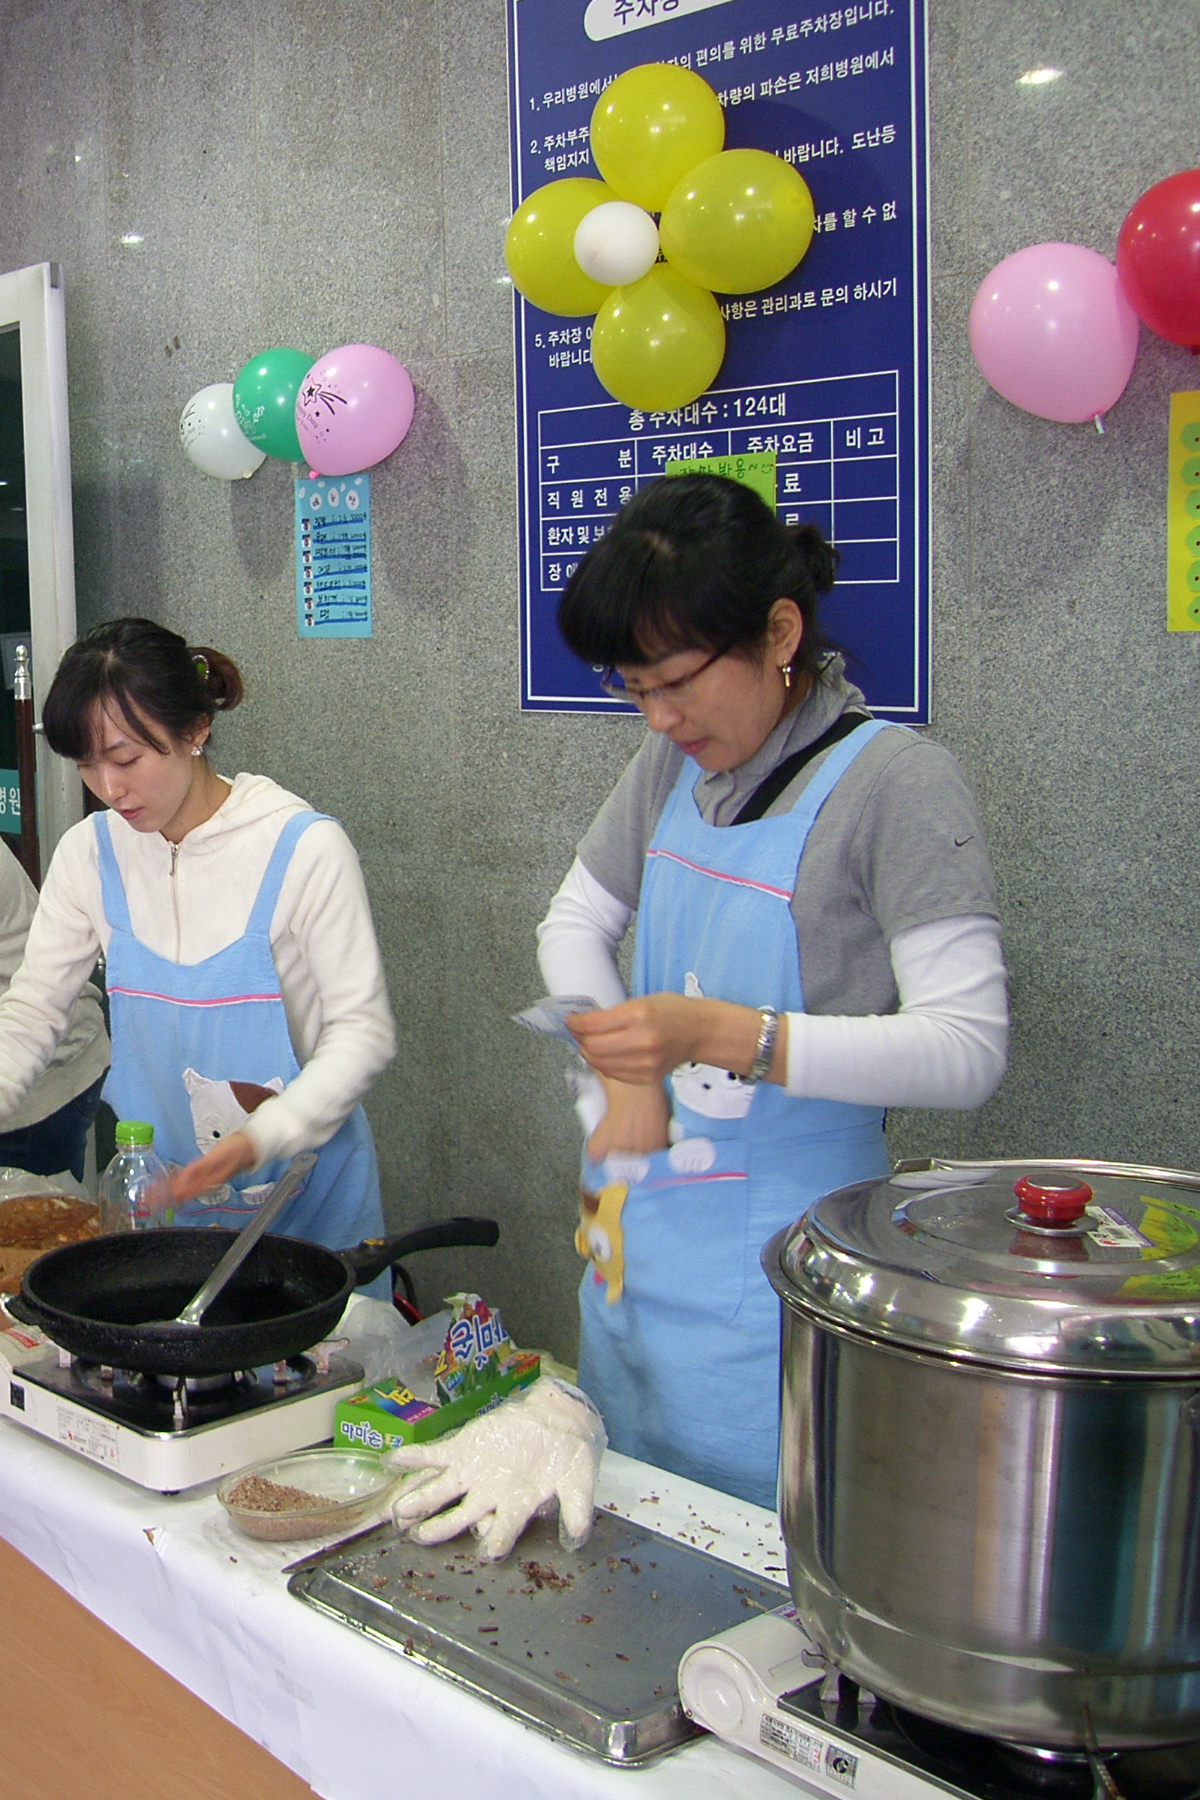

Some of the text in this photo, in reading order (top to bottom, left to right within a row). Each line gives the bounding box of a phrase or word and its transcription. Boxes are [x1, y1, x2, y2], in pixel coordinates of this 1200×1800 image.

[529, 97, 540, 111] 1.
[543, 75, 618, 108] 우리병원에서
[696, 41, 736, 67] 편의를
[739, 32, 767, 53] 위한
[771, 0, 894, 46] 무료주차장입니다.
[530, 140, 541, 154] 2.
[760, 72, 802, 97] 파손은
[806, 47, 894, 86] 저희병원에서
[544, 148, 589, 173] 책임지지
[784, 124, 896, 165] 바랍니다. 도난등
[842, 208, 857, 228] 할
[862, 206, 877, 224] 수
[882, 201, 896, 221] 없
[534, 334, 546, 349] 5.
[548, 327, 582, 347] 주차장
[761, 291, 816, 316] 관리과로
[820, 285, 848, 307] 문의
[853, 277, 897, 301] 하시기
[628, 409, 645, 431] 총
[733, 393, 787, 418] 124대
[652, 441, 714, 466] 주차대수
[747, 432, 814, 454] 주차요금
[547, 526, 574, 546] 환자
[577, 525, 589, 545] 및
[341, 1421, 382, 1448] 마미손
